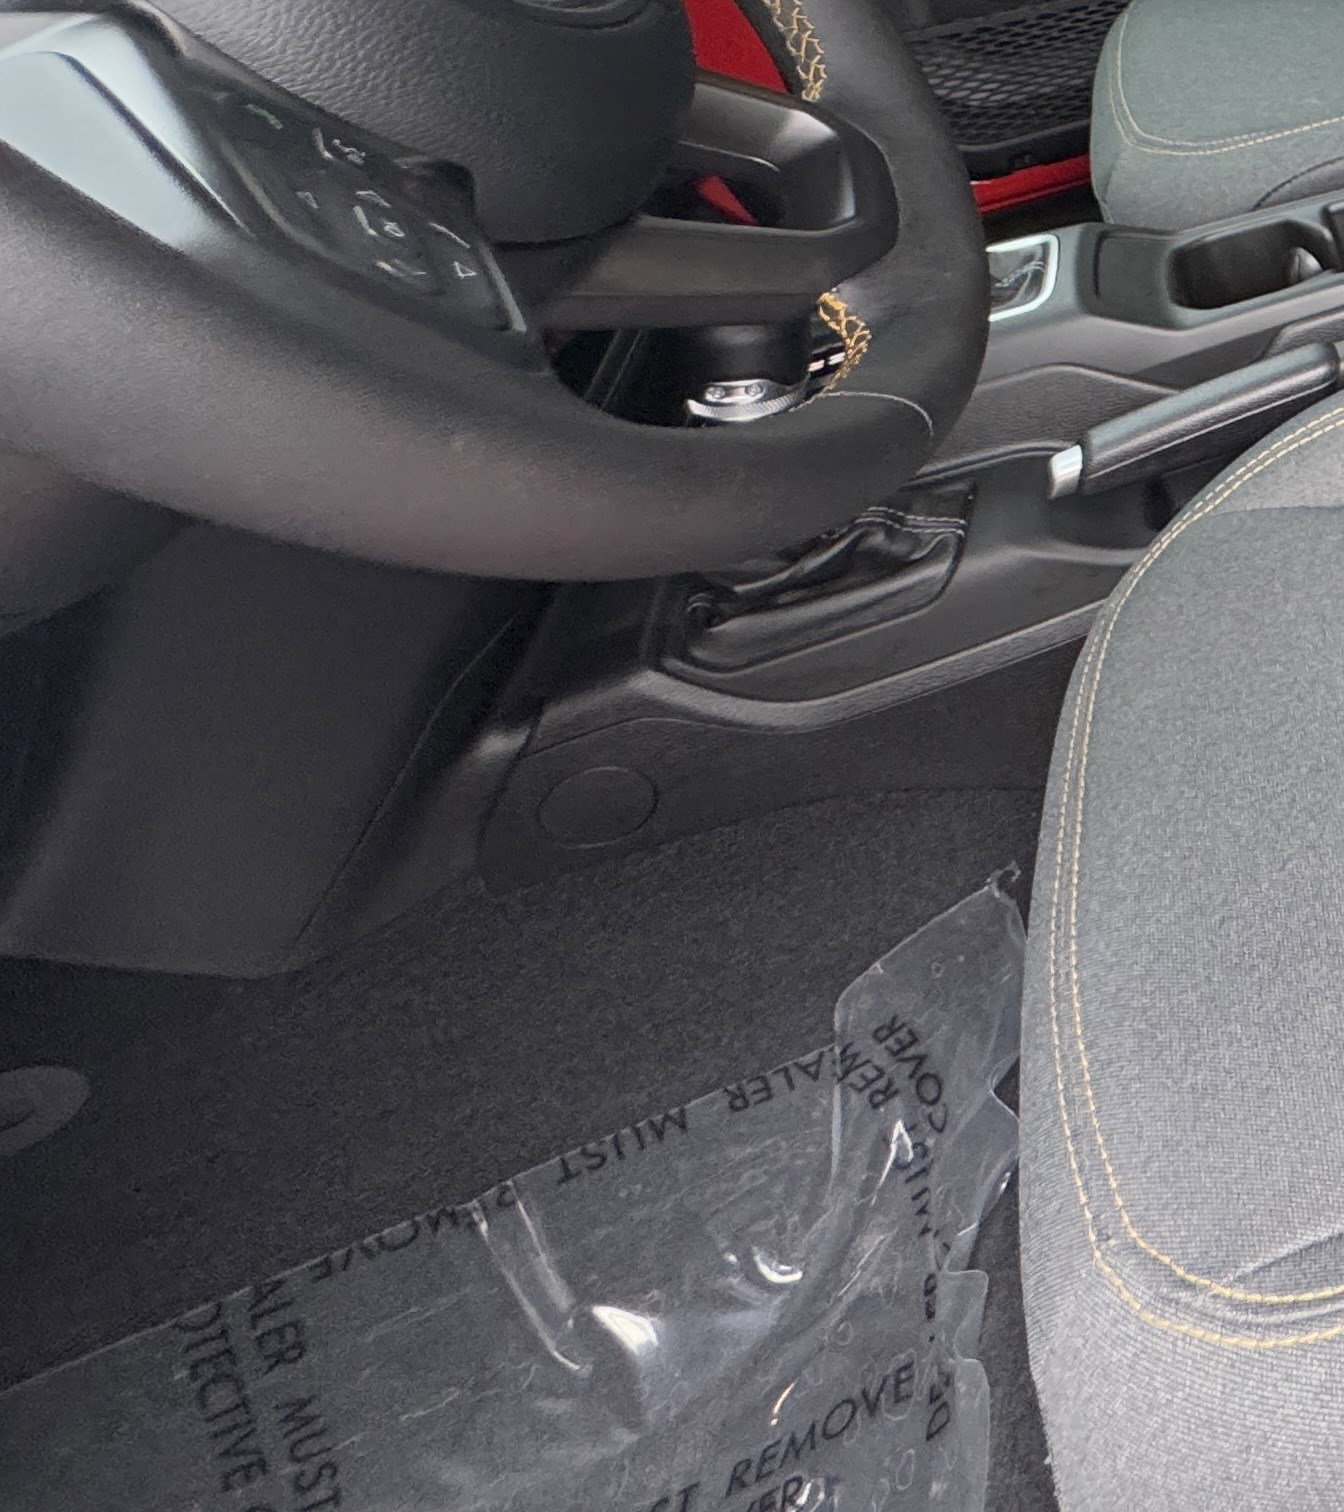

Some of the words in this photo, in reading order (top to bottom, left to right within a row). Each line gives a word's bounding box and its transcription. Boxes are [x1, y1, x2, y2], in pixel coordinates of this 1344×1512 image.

[871, 1014, 947, 1135] COVER
[275, 1395, 341, 1511] MUST
[725, 1361, 916, 1498] REMOVE
